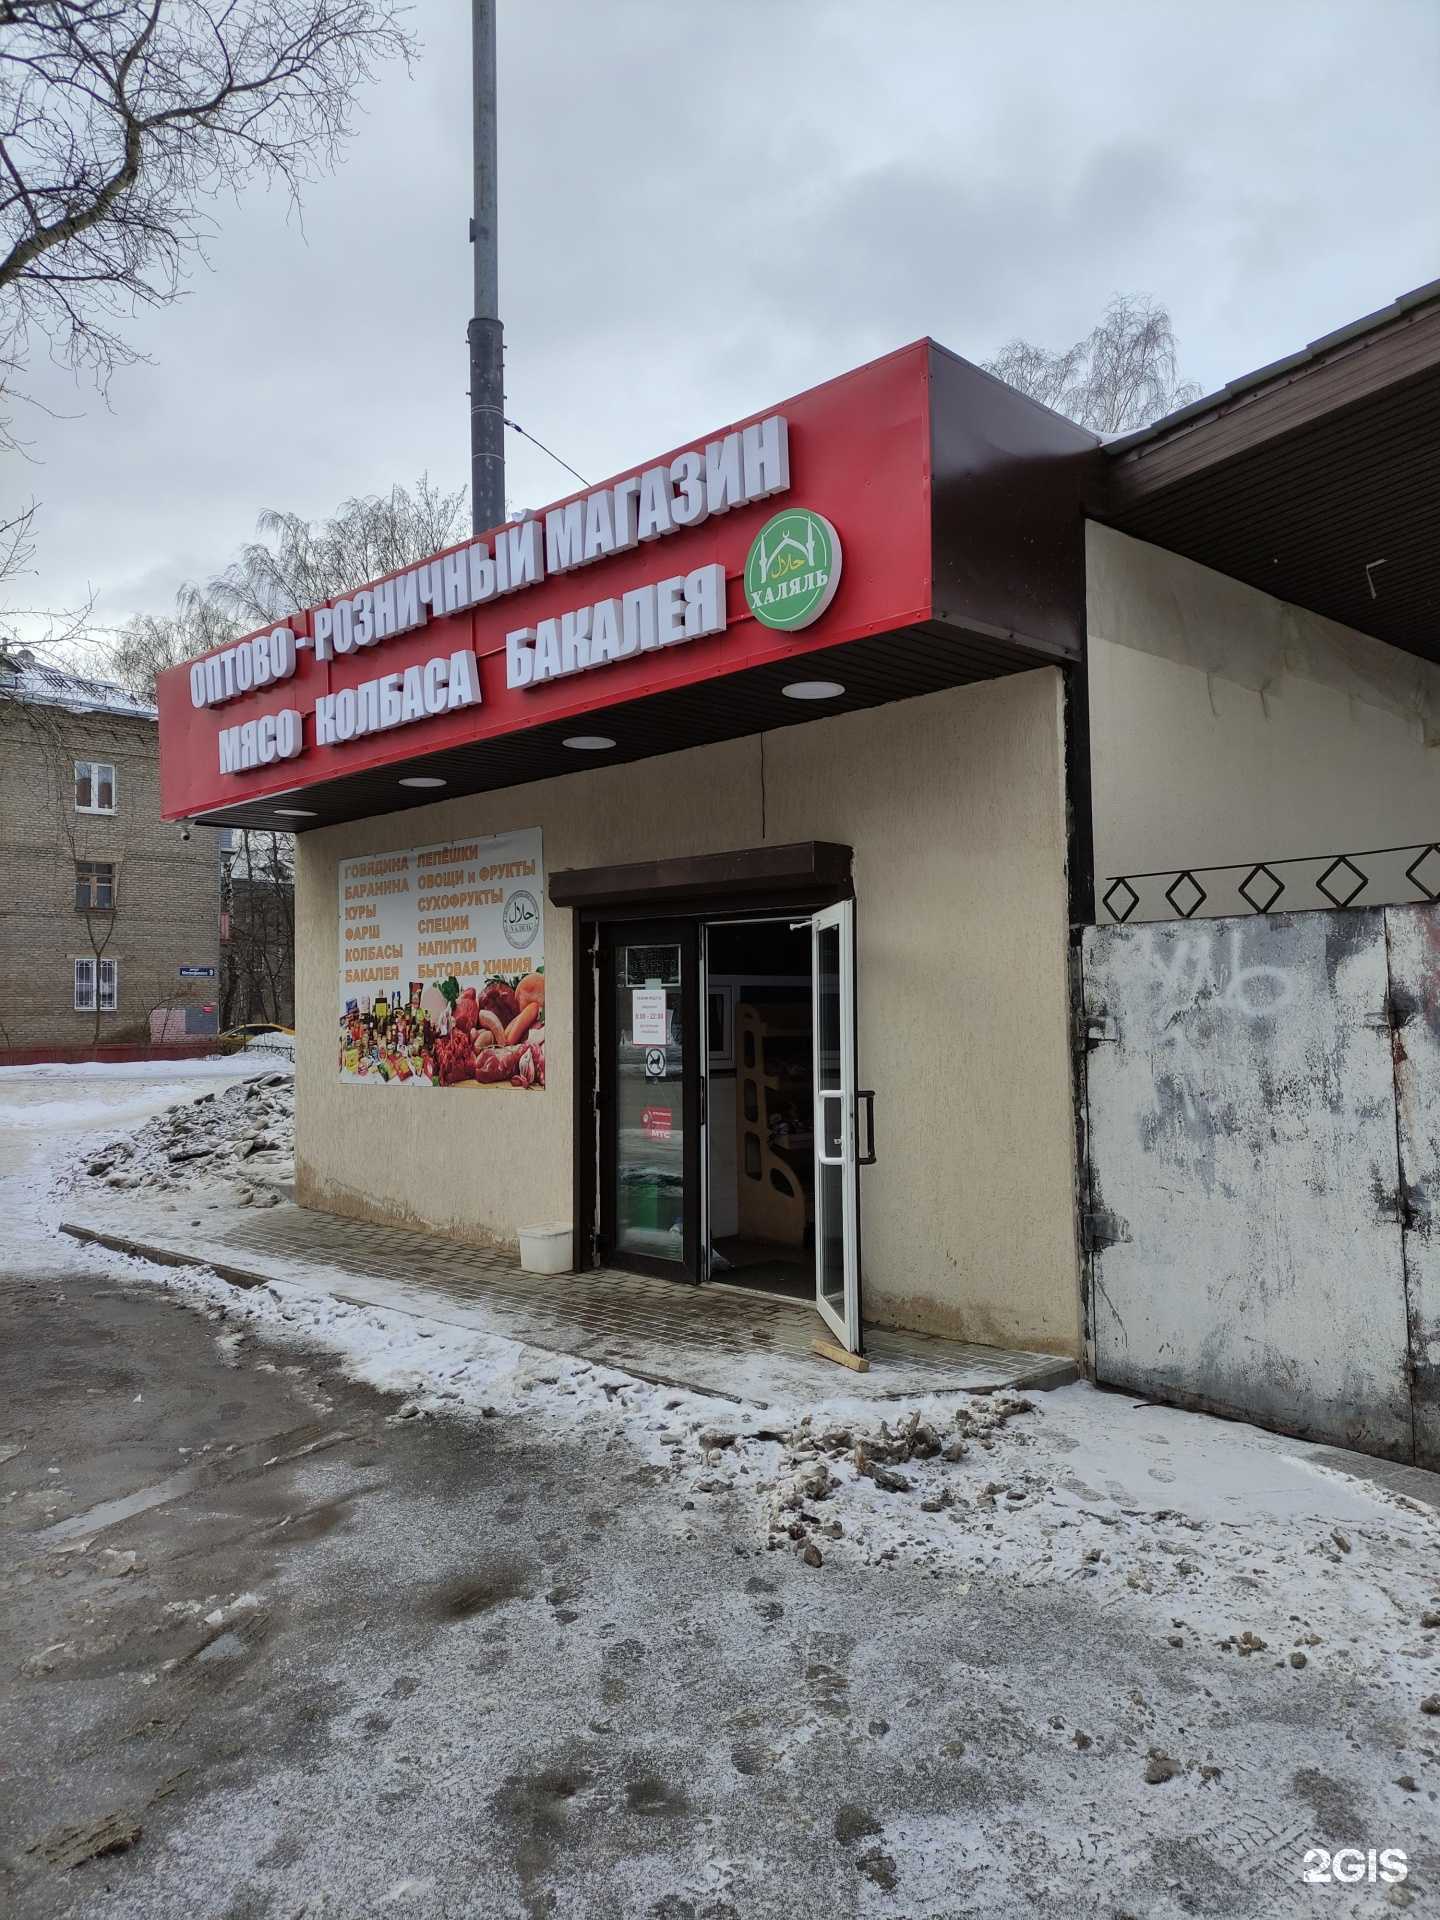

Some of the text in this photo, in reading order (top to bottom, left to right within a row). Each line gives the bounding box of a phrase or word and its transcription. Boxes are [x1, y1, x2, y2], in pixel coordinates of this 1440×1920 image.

[546, 415, 790, 575] МАГАЗИН
[751, 569, 828, 609] ХАЛЯЛЬ
[219, 563, 727, 775] МЯСО КОЛБАСА БАКАЛЕЯ
[344, 855, 409, 879] ГОВЯДИНА
[417, 869, 465, 889] ОВОЩИ
[480, 859, 536, 881] ФРУКТЫ
[345, 878, 409, 900] БАРАНИНА
[417, 888, 503, 912] СУХОФРУКТЫ
[345, 904, 377, 920] КУРЫ
[345, 925, 380, 941] ФАРШ
[417, 915, 469, 934] СПЕЦИИ
[345, 944, 403, 962] КОЛБАСЫ
[417, 938, 477, 956] НАПИТКИ
[345, 966, 400, 982] БАКАЛЕЯ
[417, 957, 532, 978] БЫТОВАЯ ХИМИЯ
[651, 1129, 671, 1139] МТС
